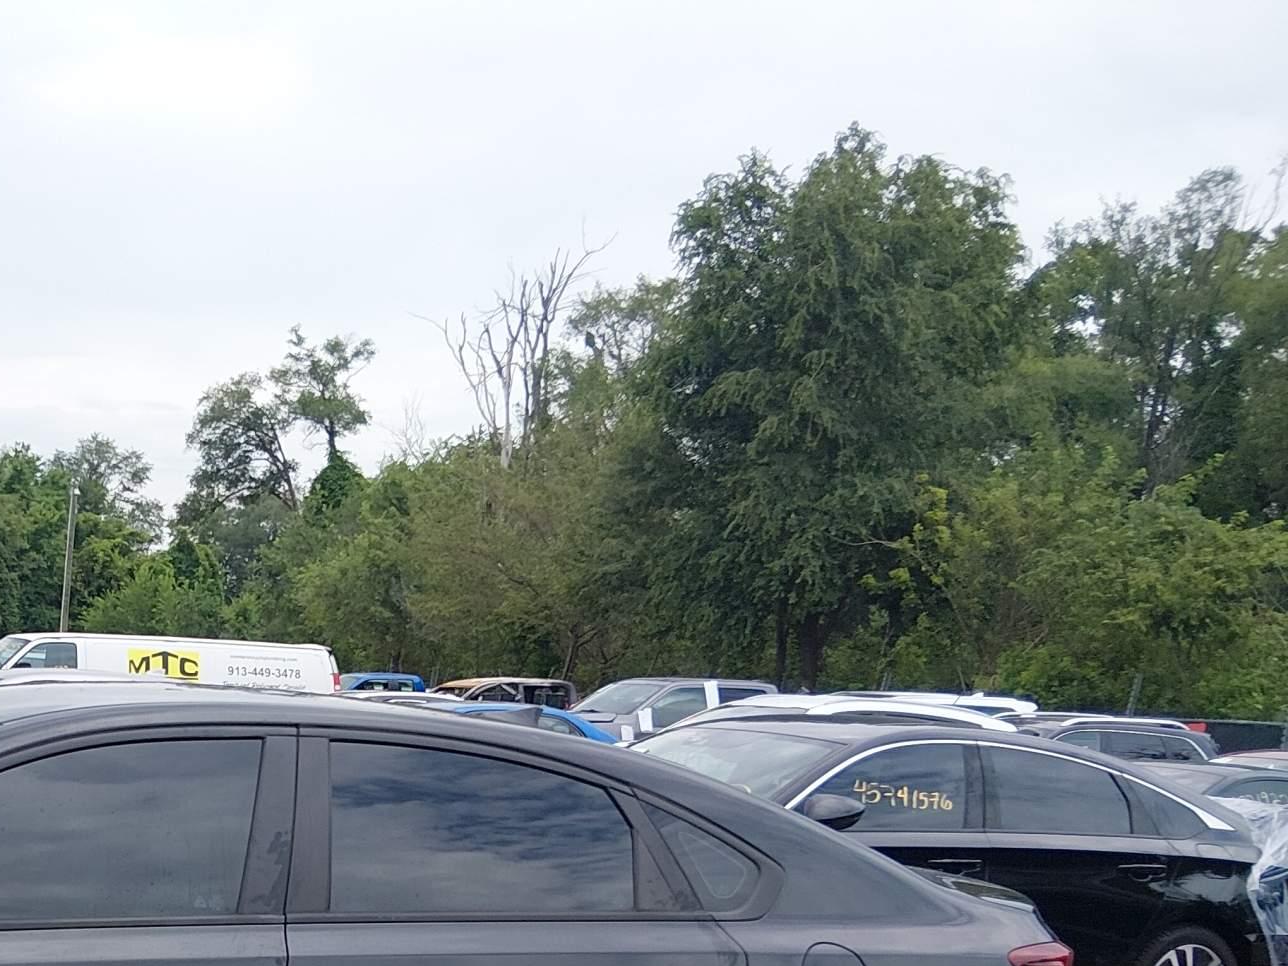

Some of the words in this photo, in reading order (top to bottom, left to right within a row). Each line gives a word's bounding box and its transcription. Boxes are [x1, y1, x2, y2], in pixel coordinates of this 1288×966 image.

[129, 651, 199, 677] MTC
[227, 665, 302, 680] 913-449-3478
[852, 779, 954, 811] 45741576
